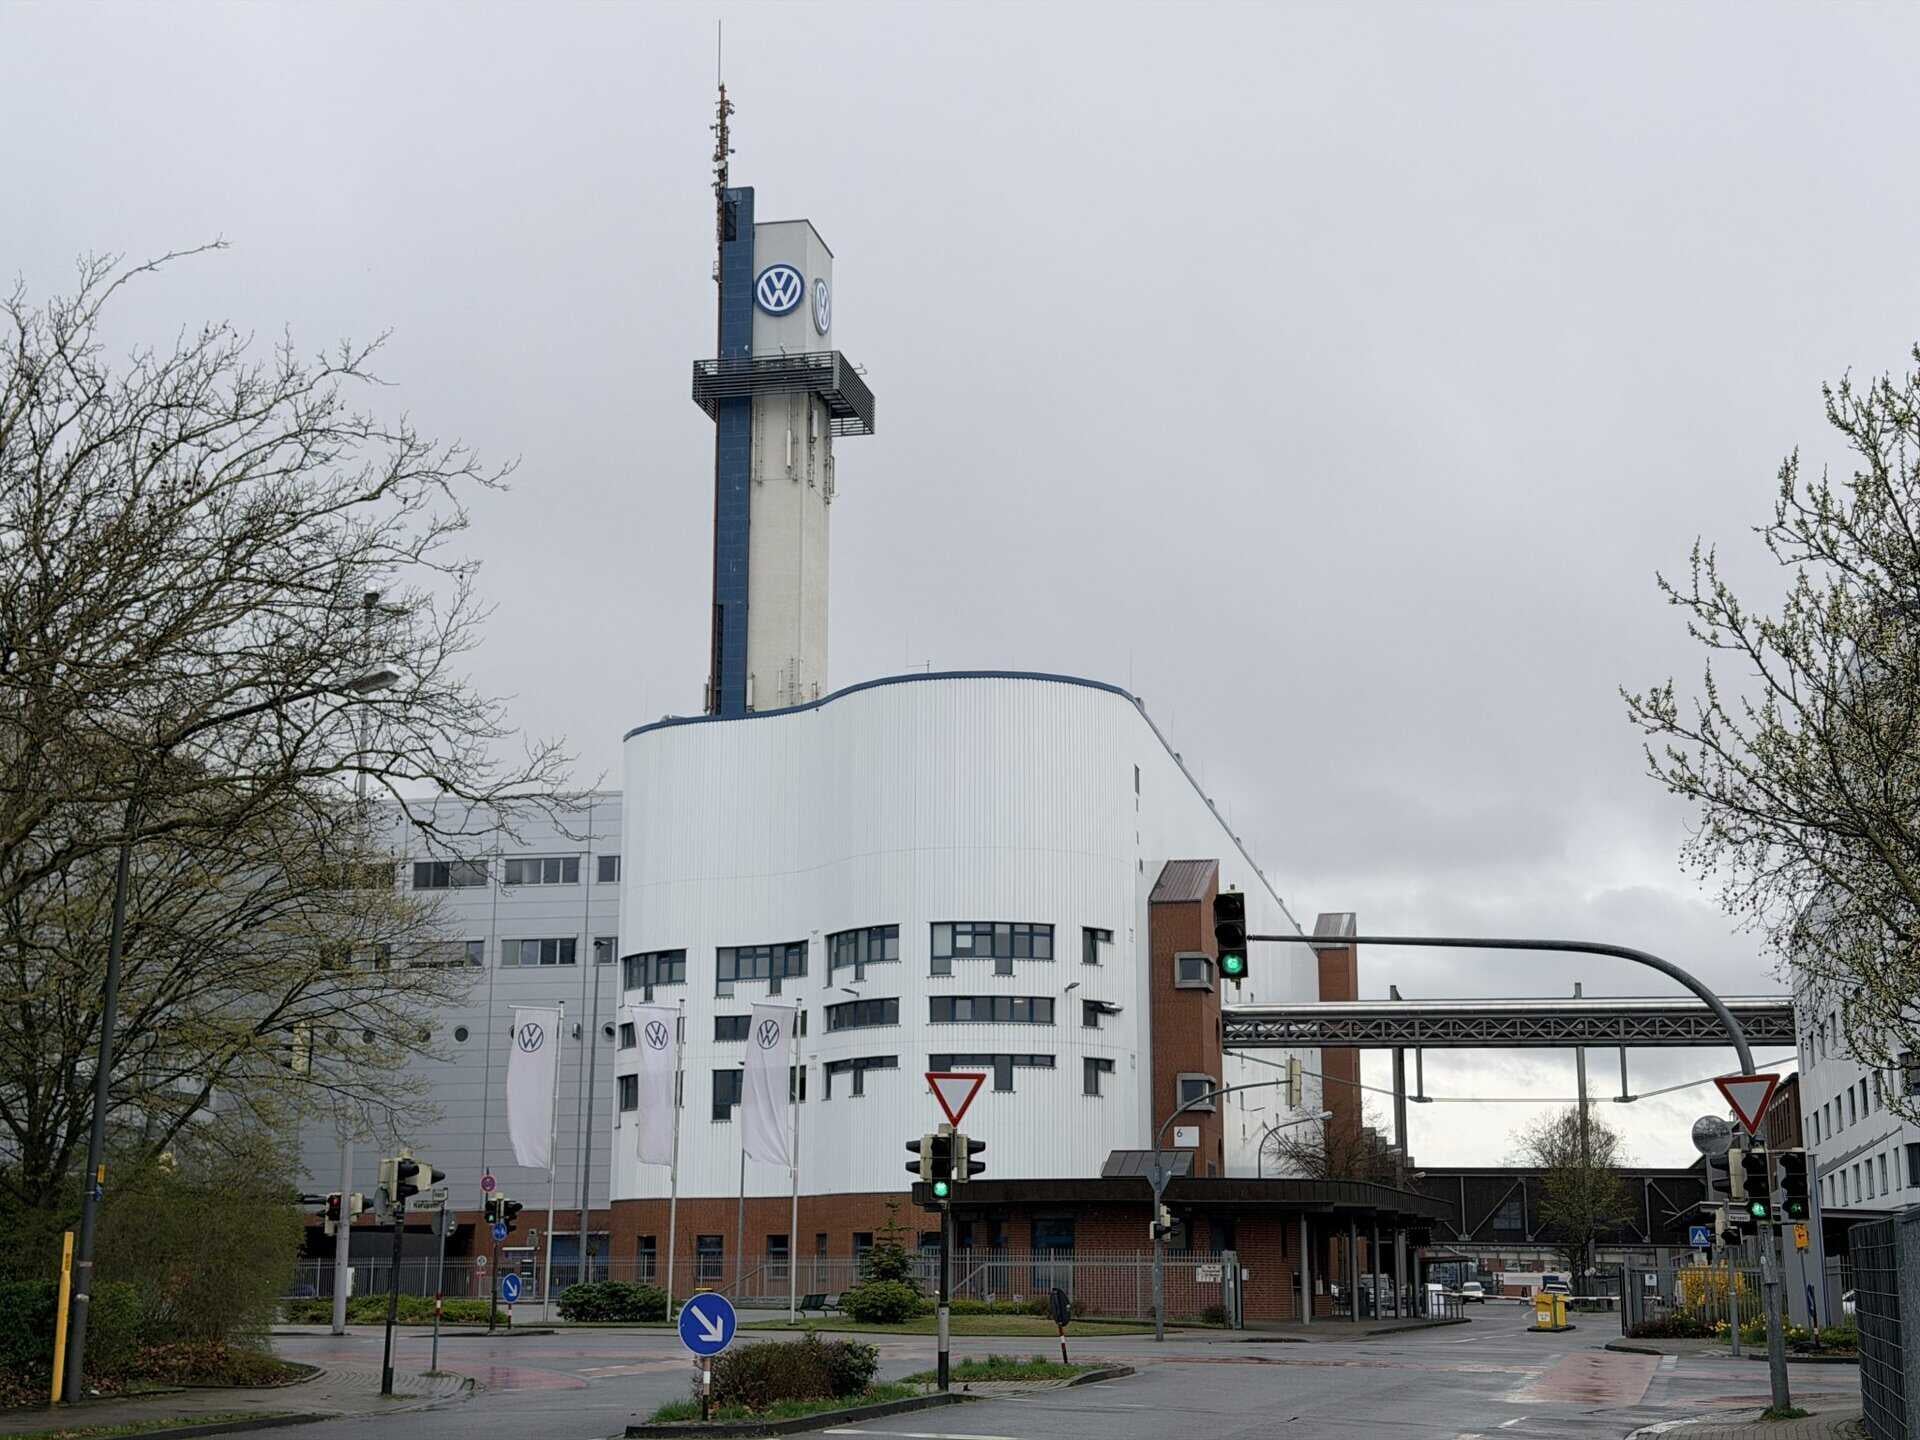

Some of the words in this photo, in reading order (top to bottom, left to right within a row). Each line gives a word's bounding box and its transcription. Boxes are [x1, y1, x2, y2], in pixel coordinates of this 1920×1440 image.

[757, 267, 801, 312] VW
[518, 1023, 544, 1052] VW
[645, 1021, 668, 1050] VW
[757, 1020, 779, 1049] VW
